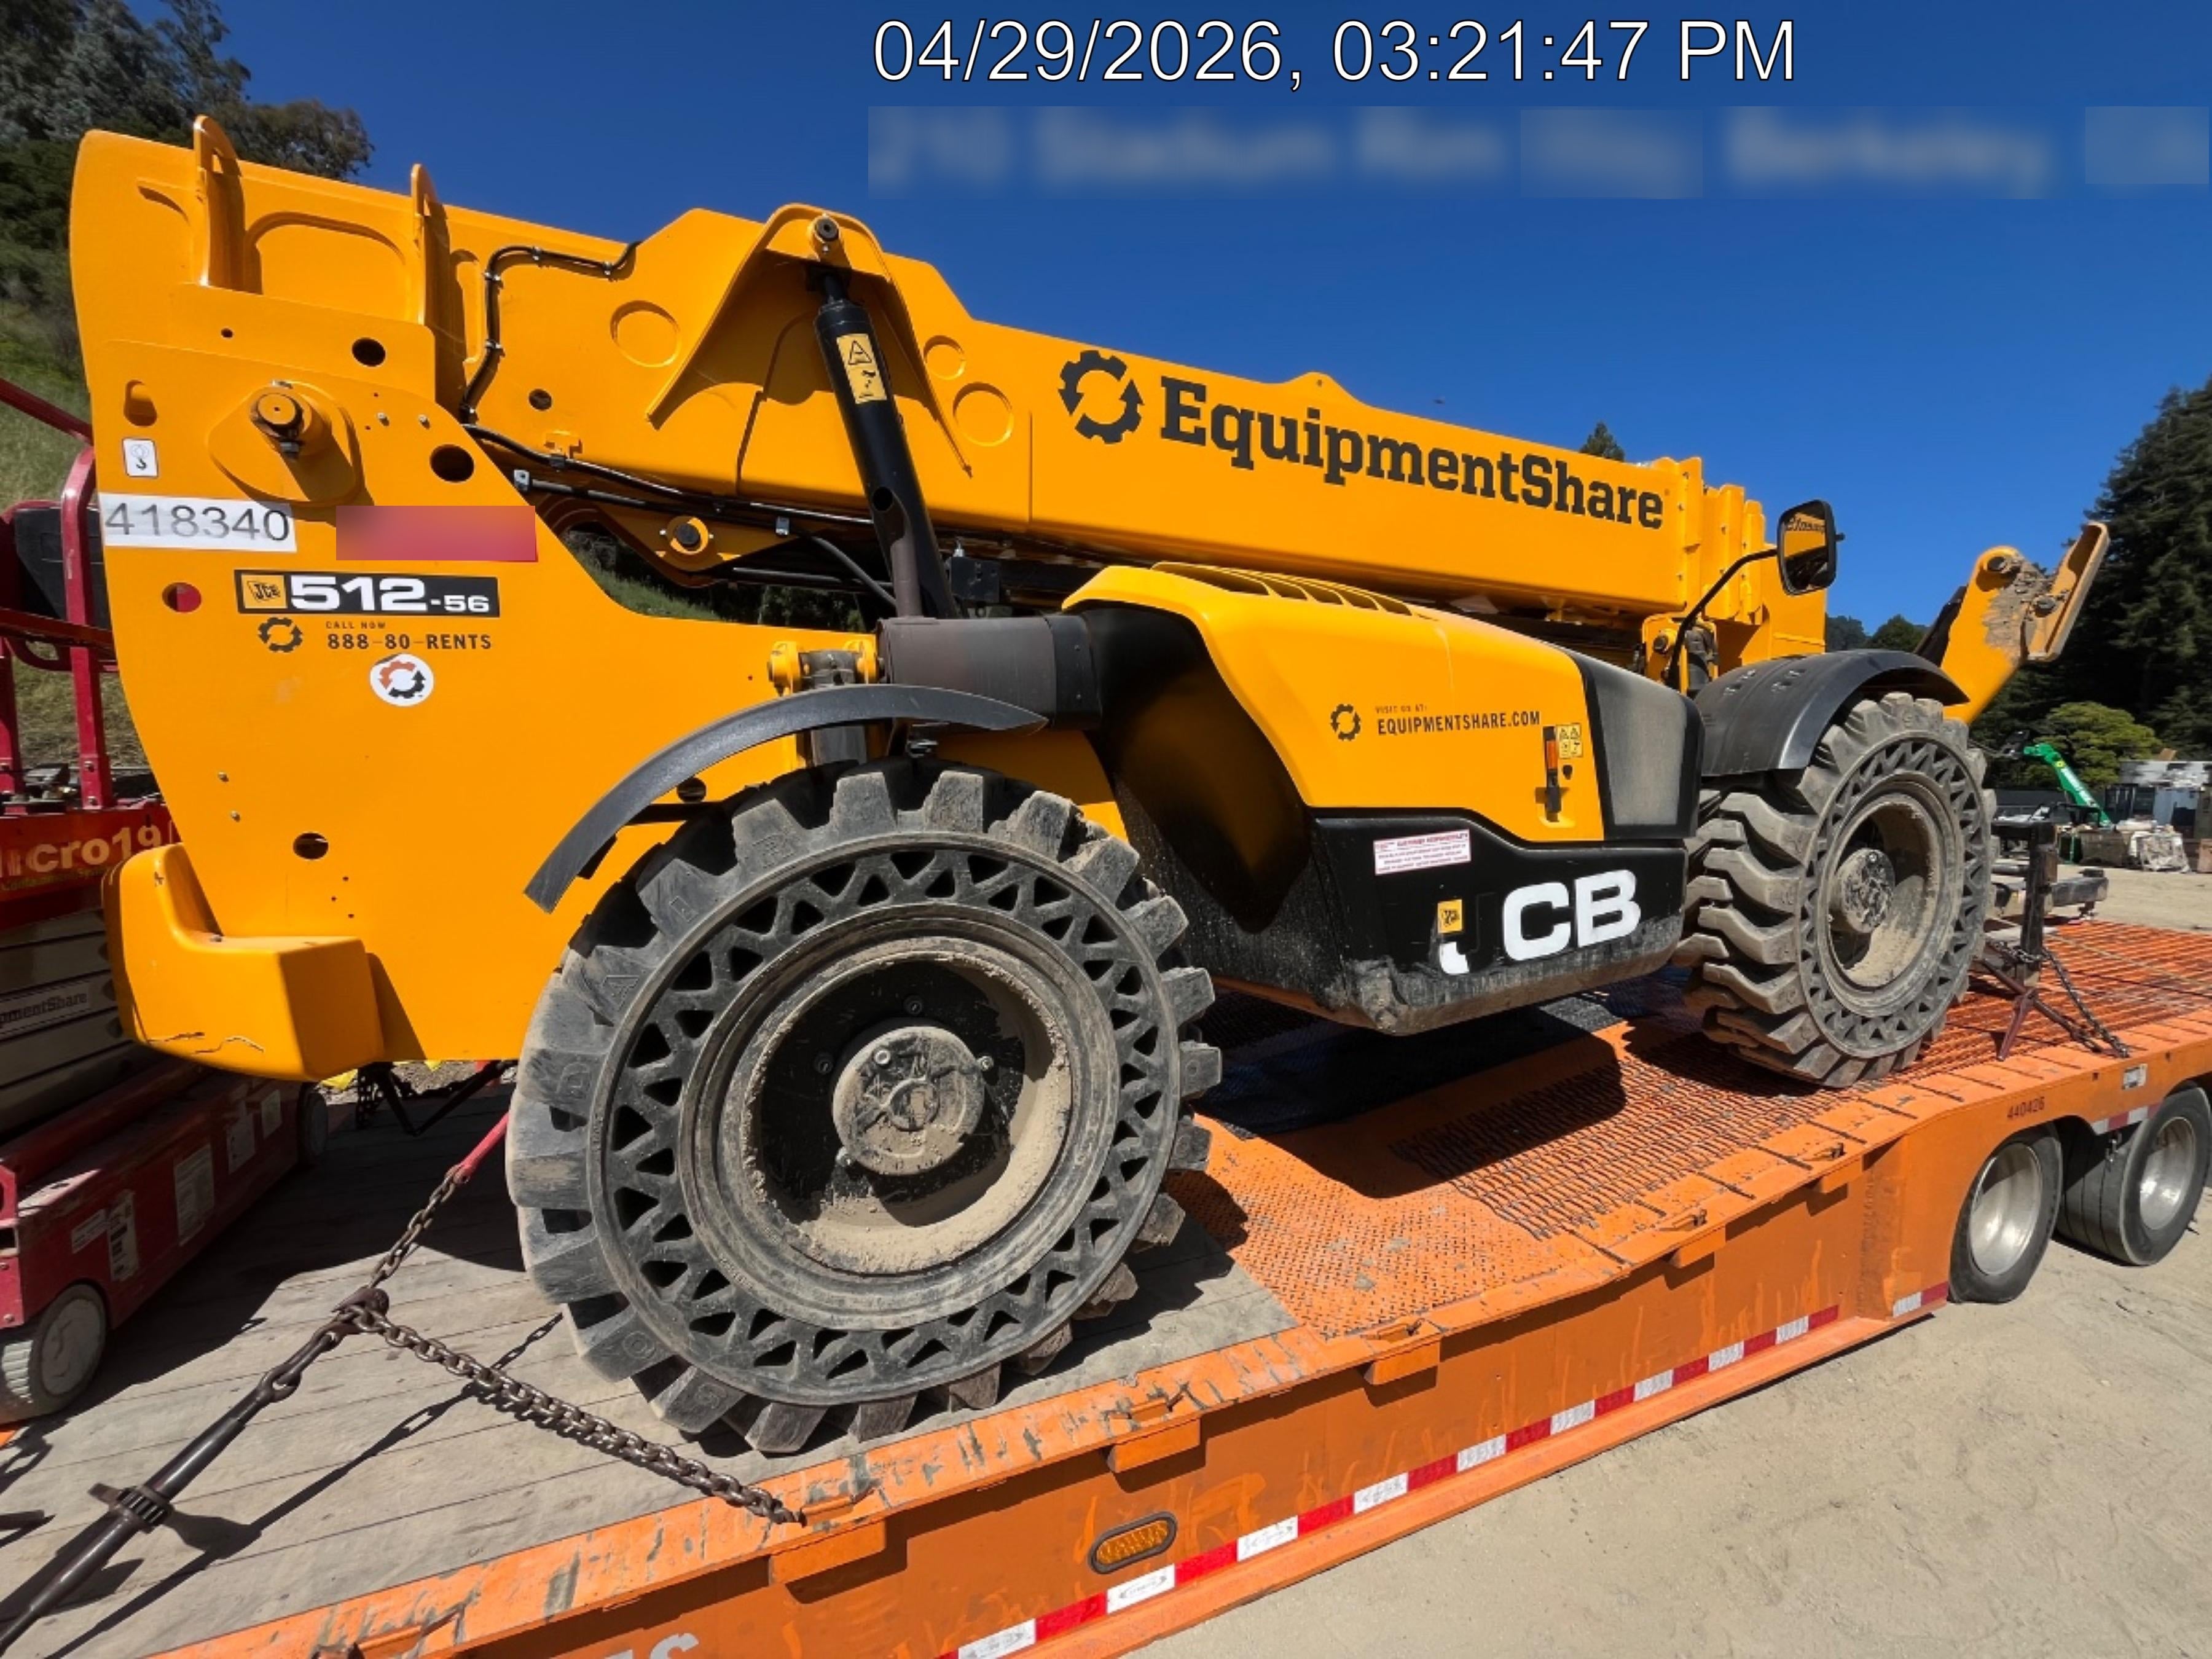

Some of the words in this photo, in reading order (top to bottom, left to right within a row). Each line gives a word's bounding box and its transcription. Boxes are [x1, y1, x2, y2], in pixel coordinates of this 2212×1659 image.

[1160, 375, 1664, 530] EquipmentShare
[104, 502, 289, 541] 418340
[326, 621, 356, 629] CALL
[361, 621, 386, 629] NOW
[1378, 710, 1540, 736] EQUIPMENTSHARE.COM
[0, 823, 162, 877] icro19
